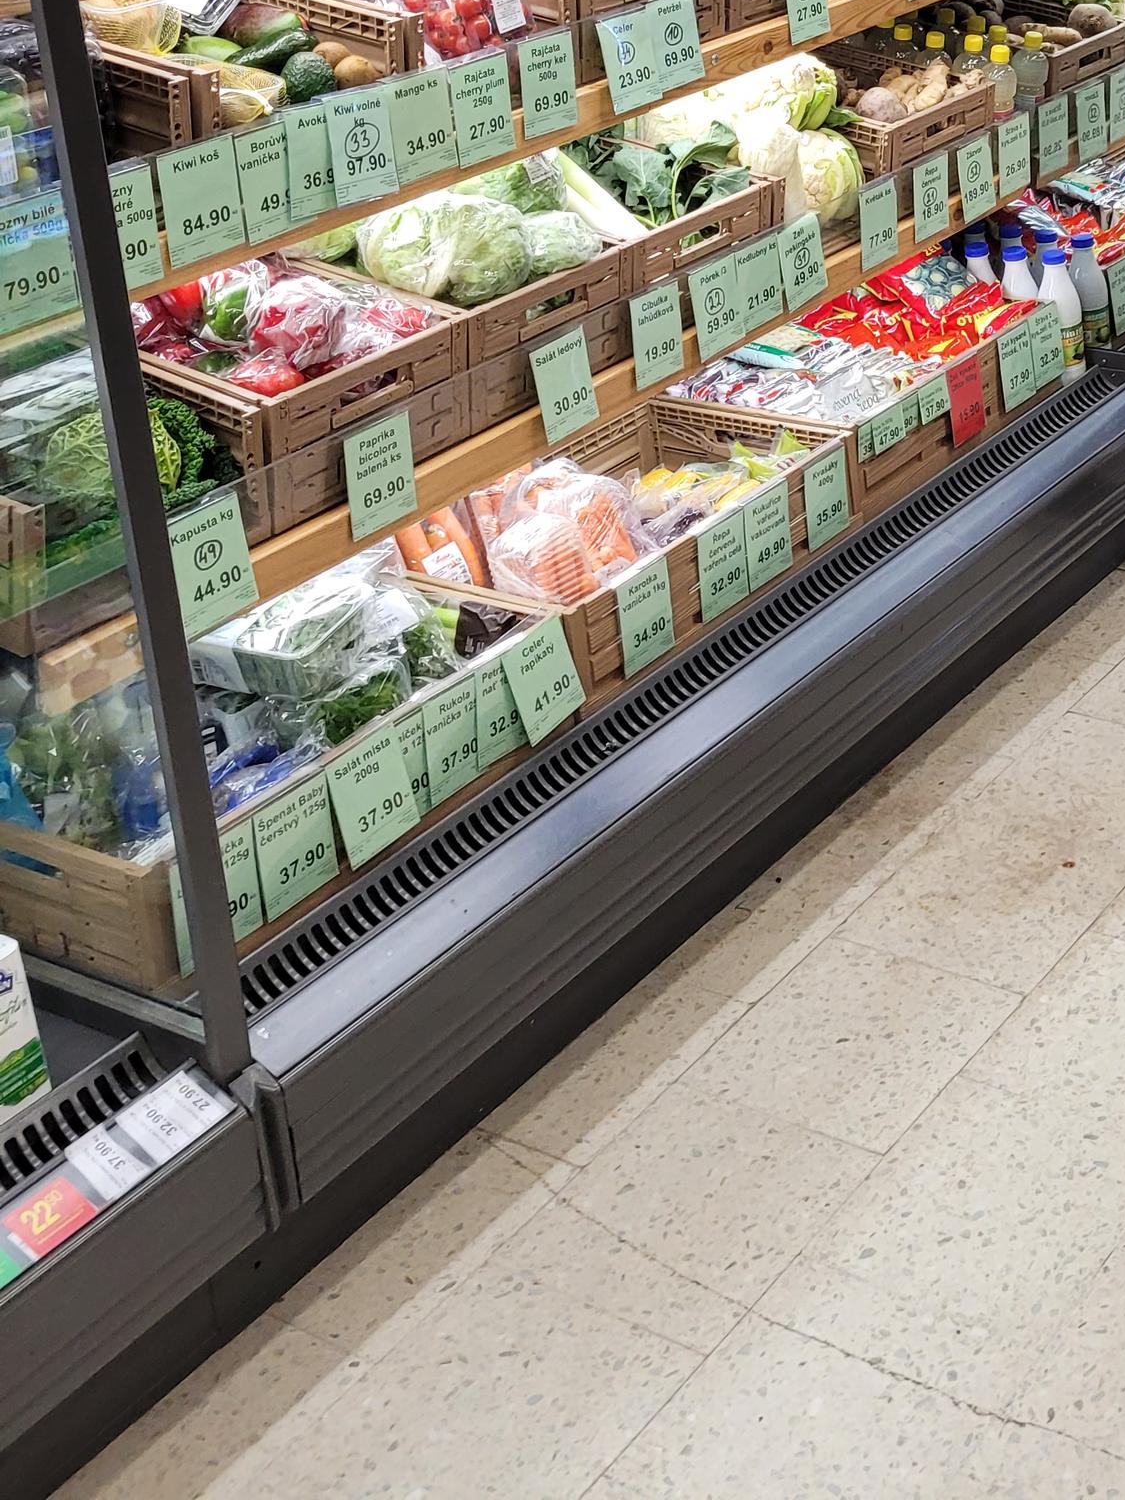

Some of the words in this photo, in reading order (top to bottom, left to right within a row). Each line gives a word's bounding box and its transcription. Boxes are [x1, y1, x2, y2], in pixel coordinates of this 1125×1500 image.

[796, 2, 823, 22] 27.90
[667, 25, 679, 41] 10
[527, 59, 553, 73] cherry
[554, 53, 567, 67] keř
[531, 43, 561, 58] Rajčata
[664, 45, 694, 67] 69.90
[464, 67, 496, 84] Rajčata
[538, 70, 558, 83] 500g
[619, 66, 651, 89] 23.90
[394, 84, 426, 100] Mango
[427, 78, 438, 90] ks
[455, 85, 483, 101] cherry
[485, 77, 505, 93] plum
[534, 90, 569, 113] 69.90
[333, 102, 354, 117] Kiwi
[355, 97, 381, 112] volné
[473, 95, 493, 109] 250g
[469, 115, 505, 141] 27.90
[350, 129, 371, 154] 33
[407, 129, 446, 155] 34.90
[172, 156, 197, 173] Kiwi
[199, 149, 220, 165] koš
[240, 152, 280, 171] vanička
[347, 153, 386, 176] 97.90
[964, 181, 989, 205] 189.90
[32, 204, 56, 220] bílé
[183, 205, 230, 236] 84.90
[922, 201, 944, 221] 18.90
[869, 227, 893, 249] 77.90
[737, 246, 767, 268] Kedlubny
[768, 241, 777, 252] ks
[4, 266, 60, 301] 79.90
[794, 262, 819, 288] 49.90
[709, 293, 722, 311] 22
[747, 285, 776, 310] 21.90
[707, 308, 735, 334] 59.90
[535, 349, 557, 367] Salát
[557, 336, 583, 356] ledový
[645, 338, 675, 364] 19.90
[1039, 347, 1059, 368] 32.30
[1009, 368, 1030, 390] 37.90
[554, 386, 588, 416] 30.90
[359, 427, 395, 451] Paprika
[358, 440, 398, 466] bicolora
[356, 459, 388, 481] balená
[390, 451, 402, 463] ks
[363, 476, 405, 509] 69.90
[816, 499, 843, 527] 35.90
[170, 516, 218, 547] Kapusta
[220, 508, 234, 522] kg
[198, 543, 217, 564] 49
[757, 537, 786, 564] 49.90
[194, 565, 242, 602] 44.90
[627, 572, 658, 596] Karotka
[710, 566, 741, 597] 32.90
[622, 592, 651, 613] vanička
[652, 581, 666, 597] 1kg
[633, 616, 666, 649] 34.90
[520, 642, 555, 675] řapíkatý
[521, 635, 545, 658] Celer
[439, 690, 472, 715] Rukola
[534, 673, 570, 713] 41.90
[426, 709, 462, 736] vanička
[334, 756, 361, 781] Salát
[354, 761, 380, 785] 200g
[258, 801, 297, 833] Špenát
[298, 784, 325, 807] Baby
[358, 791, 404, 834] 37.90
[260, 815, 299, 848] čerstvý
[301, 797, 327, 819] 125g
[279, 842, 325, 886] 37.90
[178, 1083, 210, 1112] 27.90
[146, 1108, 177, 1137] 32.90
[94, 1141, 126, 1171] 37.90
[20, 1200, 62, 1237] 22
